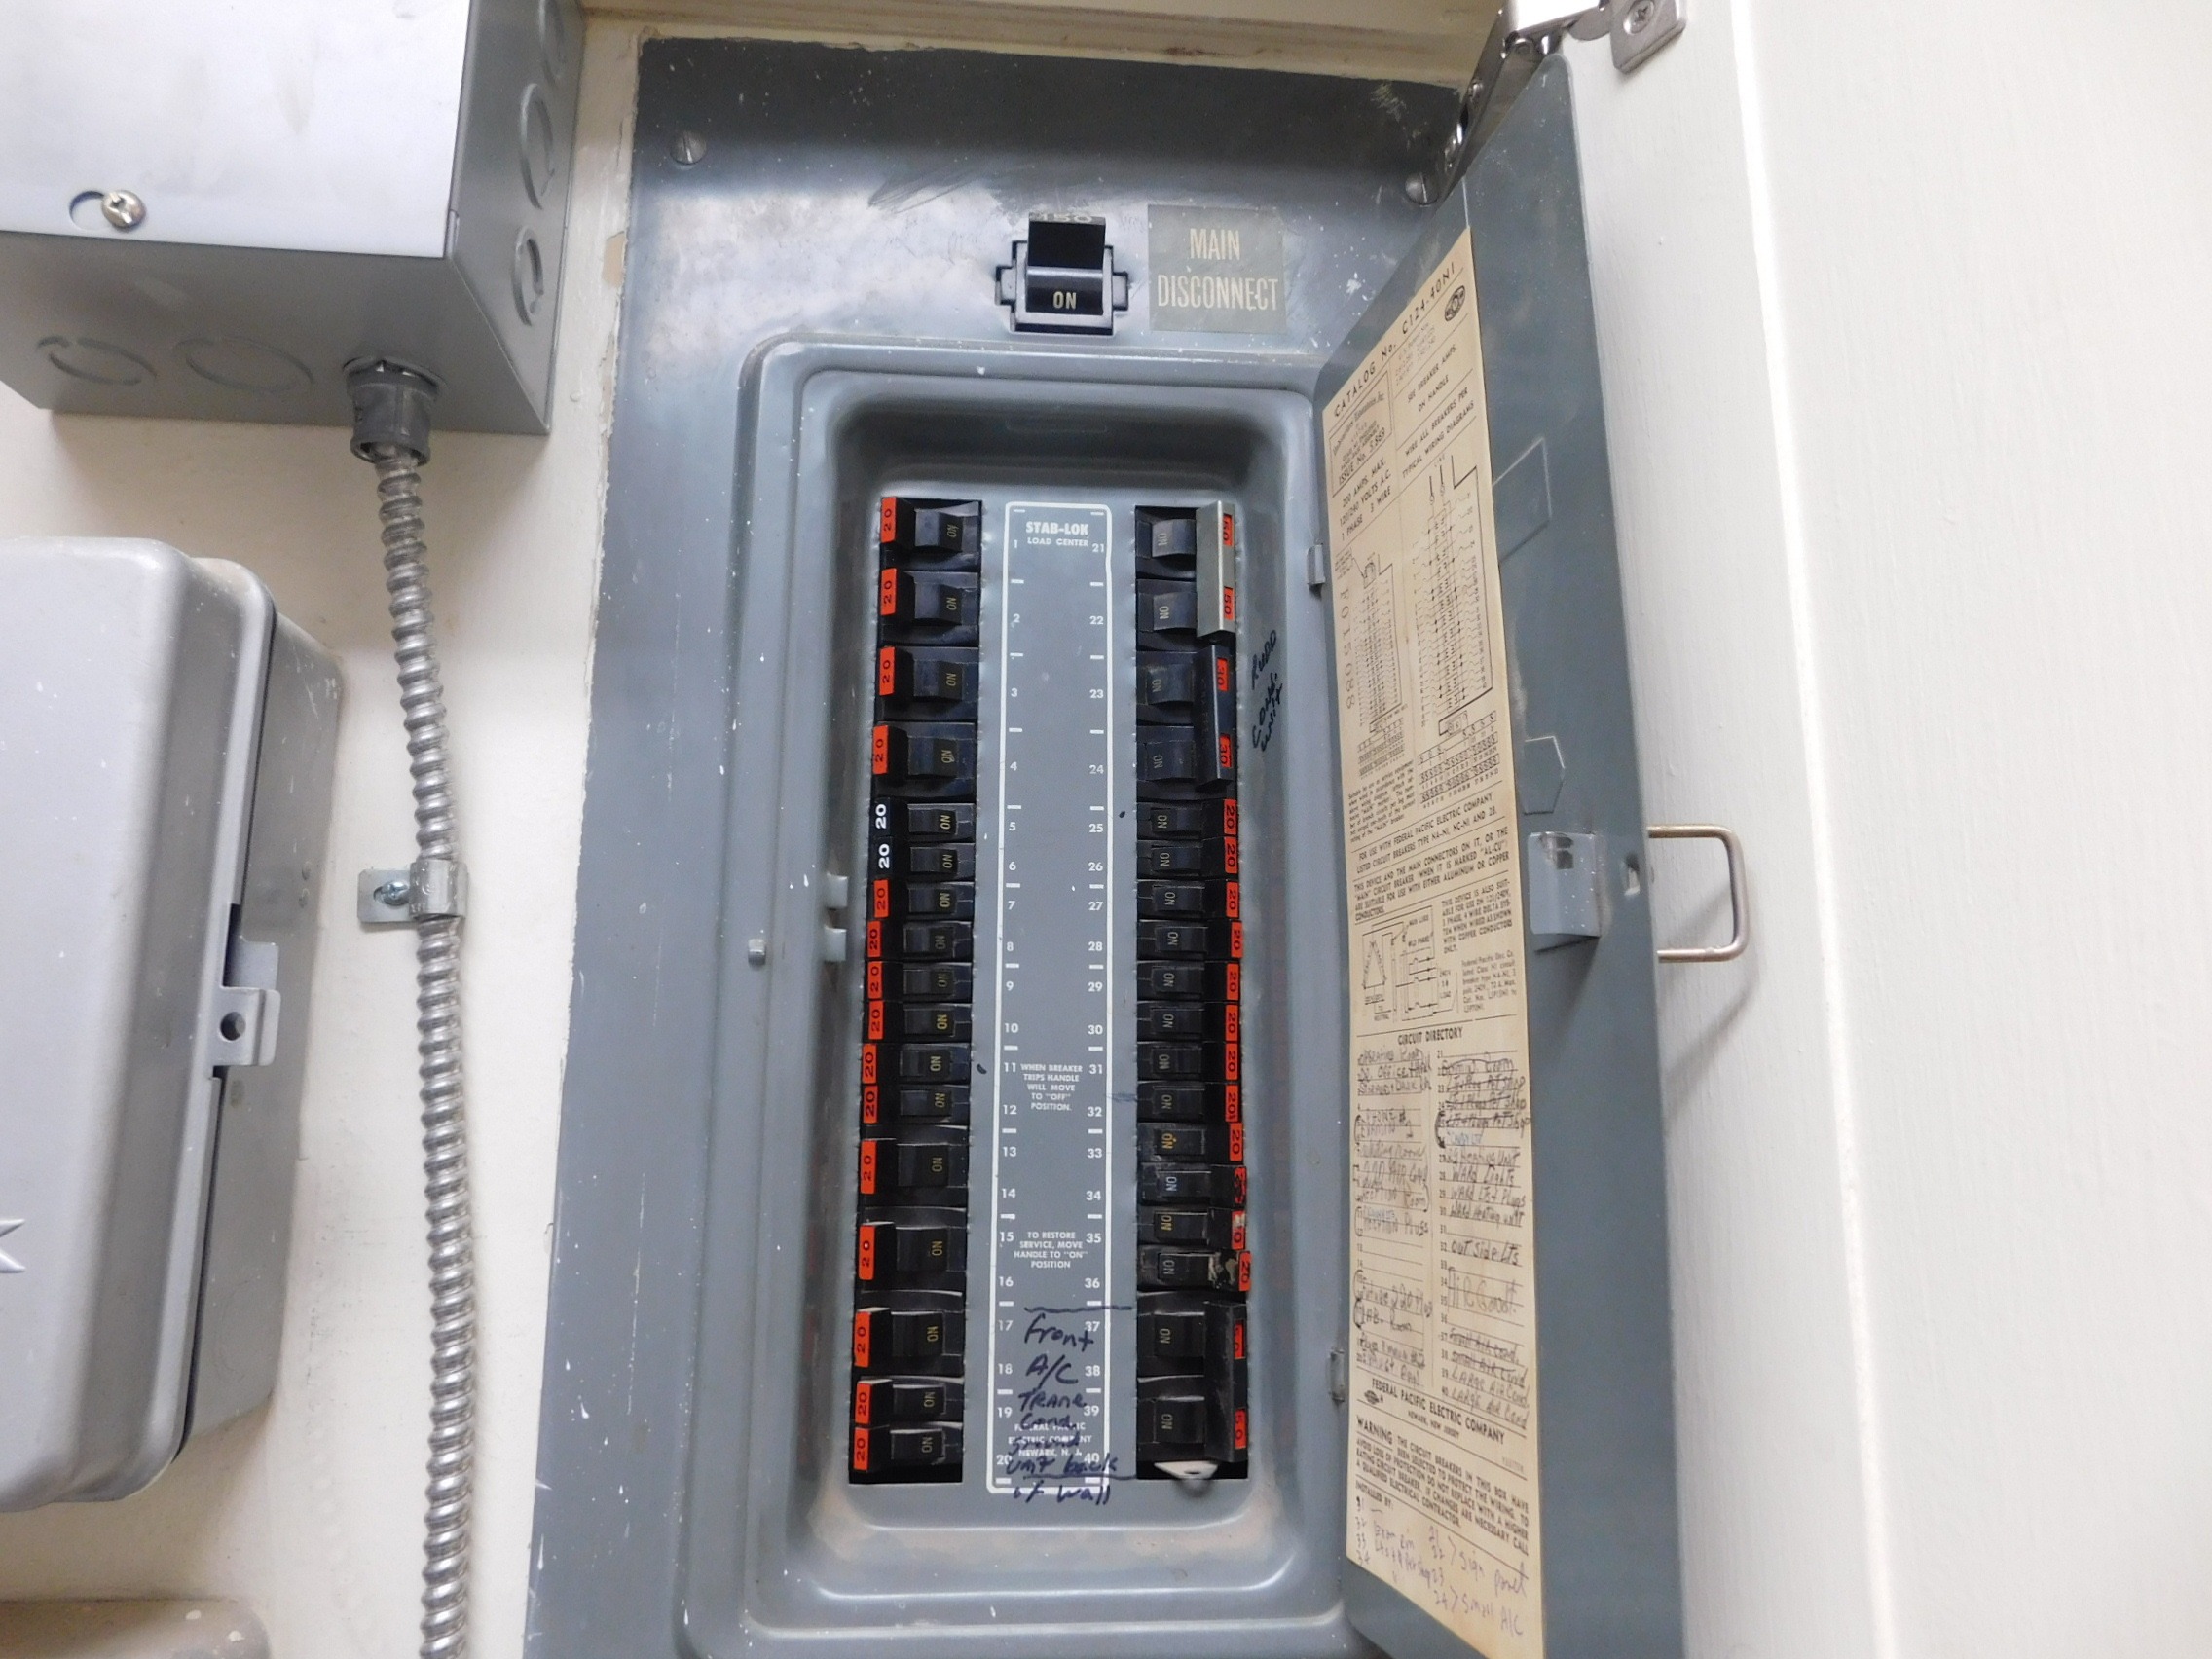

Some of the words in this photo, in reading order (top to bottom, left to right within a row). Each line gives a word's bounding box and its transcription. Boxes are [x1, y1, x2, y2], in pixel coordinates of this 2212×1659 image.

[1190, 228, 1240, 261] MAIN
[1158, 274, 1279, 311] DISCONNECT
[1052, 291, 1077, 310] ON
[1334, 361, 1376, 417] CATALOG
[884, 508, 892, 531] 20
[946, 524, 958, 538] ON
[1025, 521, 1088, 535] STAB-LOK
[1055, 538, 1088, 547] CENTER
[1091, 542, 1105, 553] 21
[883, 580, 892, 604] 20
[946, 597, 957, 610] ON
[1012, 612, 1021, 623] 2
[1160, 606, 1169, 619] ON
[1089, 615, 1104, 625] 22
[882, 660, 891, 683] 20
[946, 673, 956, 686] ON
[1010, 687, 1018, 698] 3
[1089, 688, 1104, 699] 23
[876, 739, 884, 762] 20
[941, 750, 954, 763] ON
[1009, 761, 1018, 772] 4
[1088, 764, 1104, 774] 24
[876, 803, 887, 829] 20
[940, 815, 951, 830] ON
[1158, 815, 1167, 829] ON
[1008, 821, 1016, 831] 5
[1088, 823, 1104, 833] 25
[878, 843, 890, 869] 20
[942, 854, 953, 868] ON
[1160, 853, 1169, 866] ON
[1008, 861, 1017, 871] 6
[1088, 861, 1104, 872] 26
[876, 888, 886, 910] 20
[939, 893, 950, 907] ON
[1008, 900, 1016, 910] 7
[1165, 892, 1175, 905] ON
[1088, 901, 1104, 911] 27
[869, 929, 877, 950] 20
[1168, 932, 1178, 945] ON
[1006, 940, 1014, 952] 8
[1088, 940, 1103, 952] 28
[870, 966, 879, 991] 20
[1005, 980, 1014, 991] 9
[1088, 981, 1103, 992] 29
[871, 1009, 880, 1032] 20
[937, 1014, 947, 1029] ON
[1004, 1022, 1019, 1034] 10
[1088, 1024, 1104, 1035] 30
[1398, 1032, 1422, 1046] CIRCUIT
[1425, 1026, 1463, 1042] DIRECTORY
[865, 1052, 873, 1077] 20
[930, 1056, 941, 1071] ON
[1004, 1061, 1016, 1073] 11
[1020, 1063, 1046, 1072] WHEN
[1088, 1063, 1103, 1075] 31
[866, 1091, 874, 1117] 20
[935, 1093, 945, 1108] ON
[1030, 1102, 1072, 1111] POSITION.
[1003, 1104, 1017, 1115] 12
[1087, 1106, 1102, 1118] 32
[1161, 1133, 1173, 1149] ON
[1003, 1146, 1017, 1158] 13
[1087, 1147, 1103, 1159] 33
[864, 1155, 872, 1181] 20
[1166, 1176, 1176, 1192] ON
[1001, 1188, 1016, 1198] 14
[1086, 1190, 1102, 1201] 34
[1161, 1215, 1172, 1231] ON
[999, 1231, 1014, 1243] 15
[1086, 1233, 1102, 1244] 35
[999, 1275, 1014, 1287] 16
[1084, 1277, 1100, 1289] 36
[998, 1319, 1014, 1331] 17
[1085, 1320, 1101, 1332] 37
[927, 1326, 938, 1342] ON
[1024, 1313, 1094, 1352] Front
[1160, 1328, 1171, 1344] ON
[857, 1327, 866, 1353] 20
[998, 1362, 1014, 1375] 18
[1025, 1354, 1079, 1389] A/C
[1085, 1364, 1101, 1377] 38
[858, 1392, 866, 1416] 20
[924, 1392, 935, 1407] ON
[997, 1406, 1013, 1419] 19
[1083, 1405, 1100, 1417] 39
[1372, 1378, 1397, 1398] FEDERAL
[1401, 1389, 1426, 1410] PACIFIC
[1429, 1402, 1461, 1426] ELECTRIC
[1465, 1417, 1504, 1445] COMPANY
[1014, 1423, 1049, 1432] FERAL
[1161, 1414, 1173, 1430] ON
[1356, 1415, 1393, 1445] WARNING
[857, 1438, 866, 1461] 20
[922, 1437, 932, 1453] ON
[996, 1454, 1013, 1465] 20
[1083, 1452, 1100, 1464] 40
